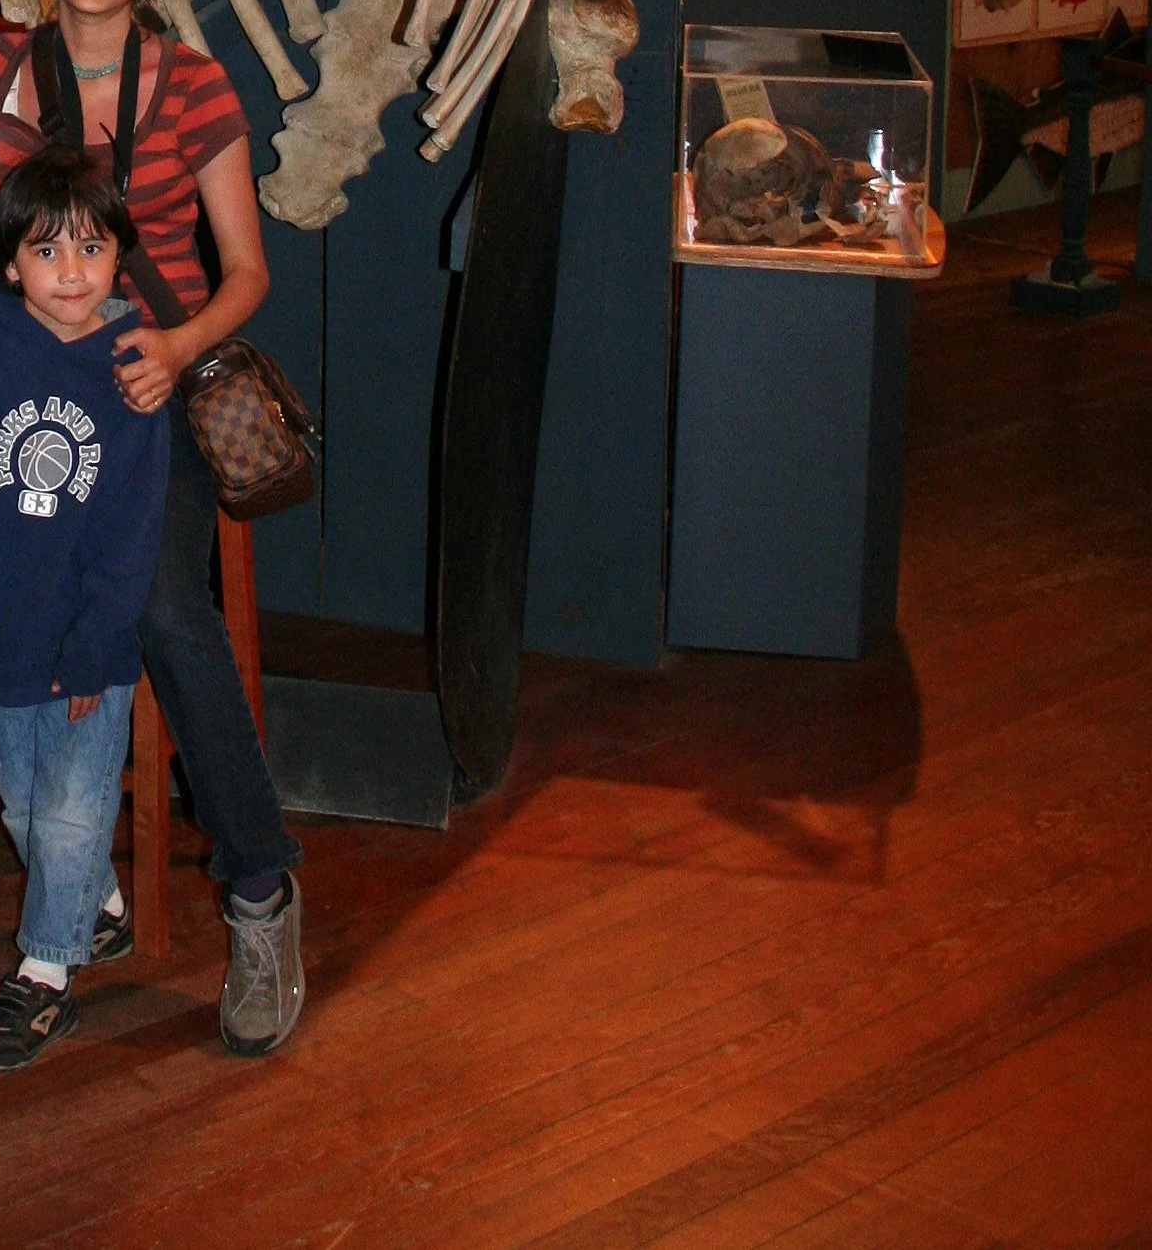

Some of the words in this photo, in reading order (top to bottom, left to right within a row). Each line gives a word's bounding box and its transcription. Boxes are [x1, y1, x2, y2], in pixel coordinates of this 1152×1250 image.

[41, 396, 95, 442] AND
[68, 443, 101, 503] REC
[22, 492, 54, 515] 63
